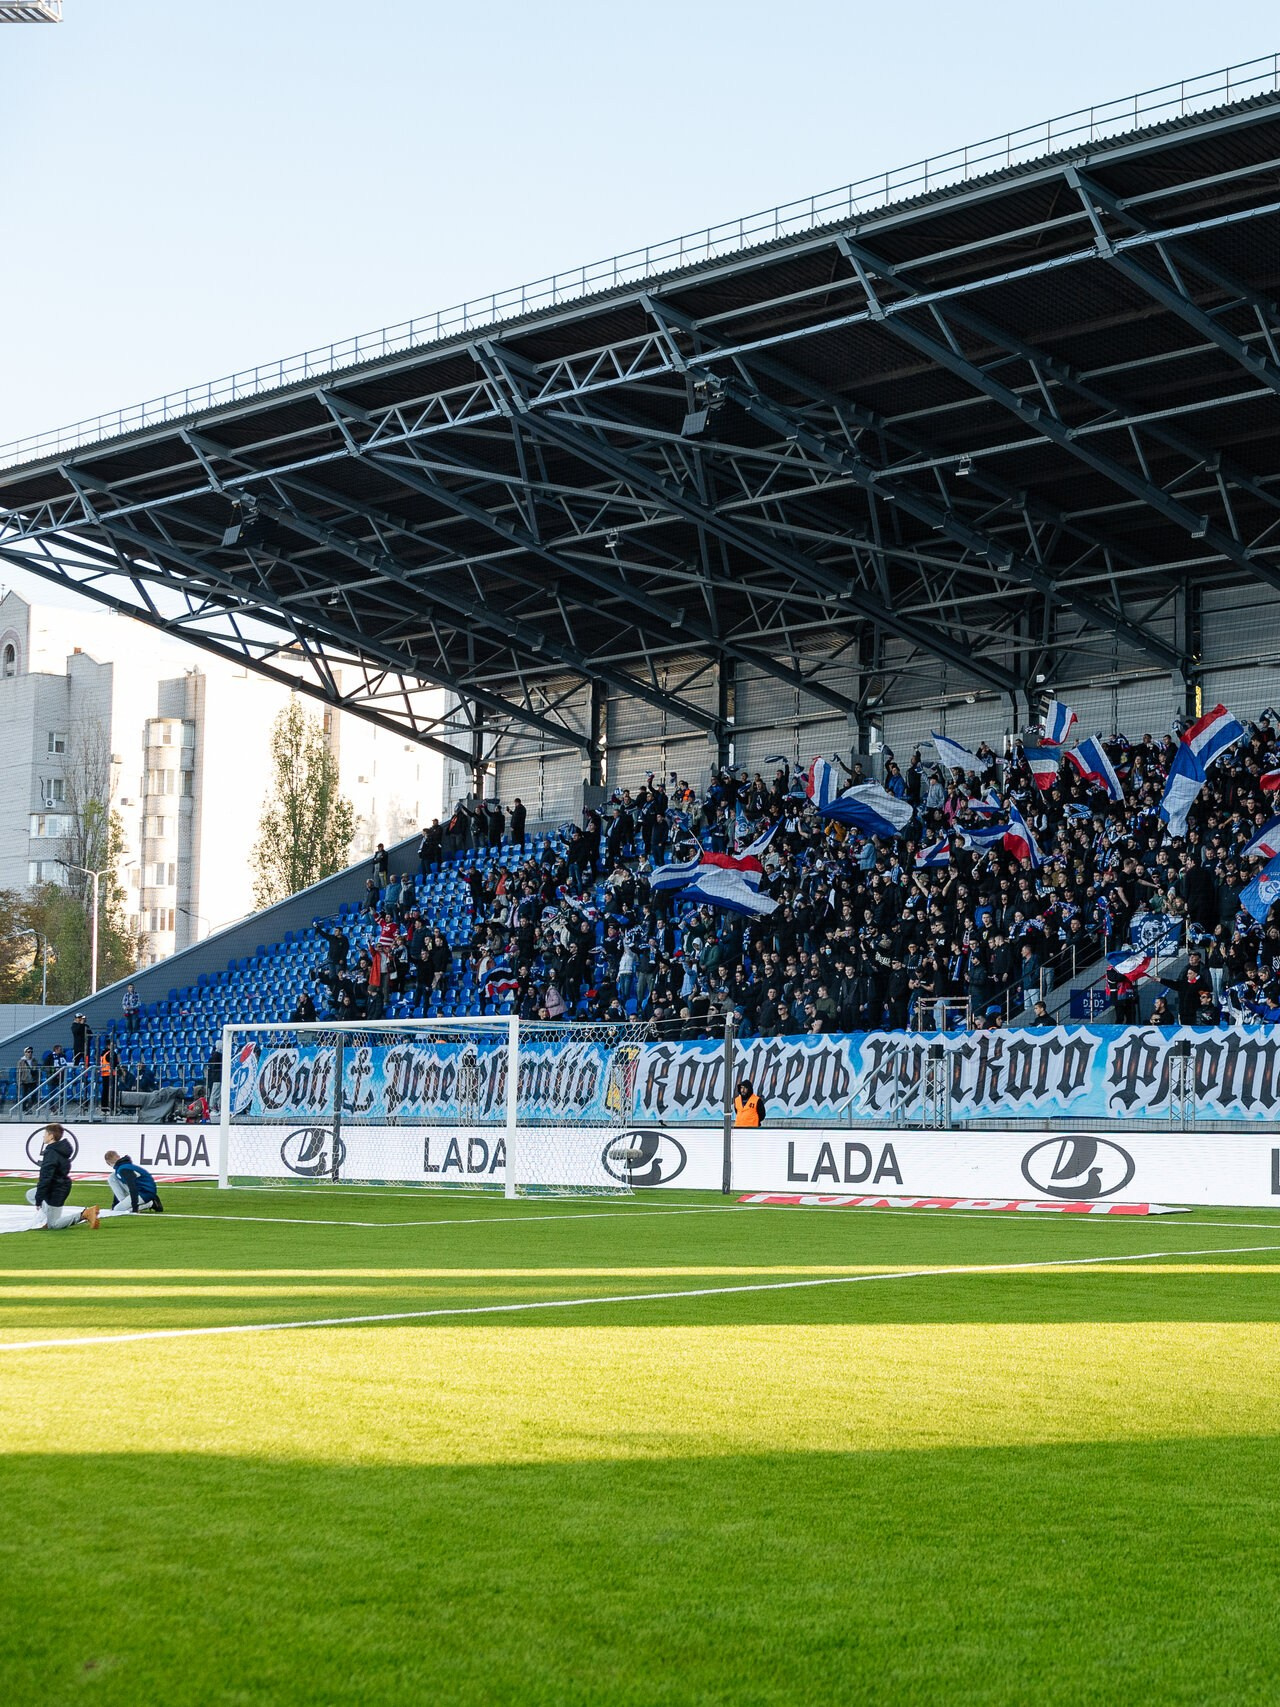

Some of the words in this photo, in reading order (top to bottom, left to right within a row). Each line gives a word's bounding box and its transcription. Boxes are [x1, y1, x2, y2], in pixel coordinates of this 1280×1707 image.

[139, 1134, 209, 1168] LADA
[423, 1137, 507, 1174] LADA
[787, 1141, 903, 1185] LADA
